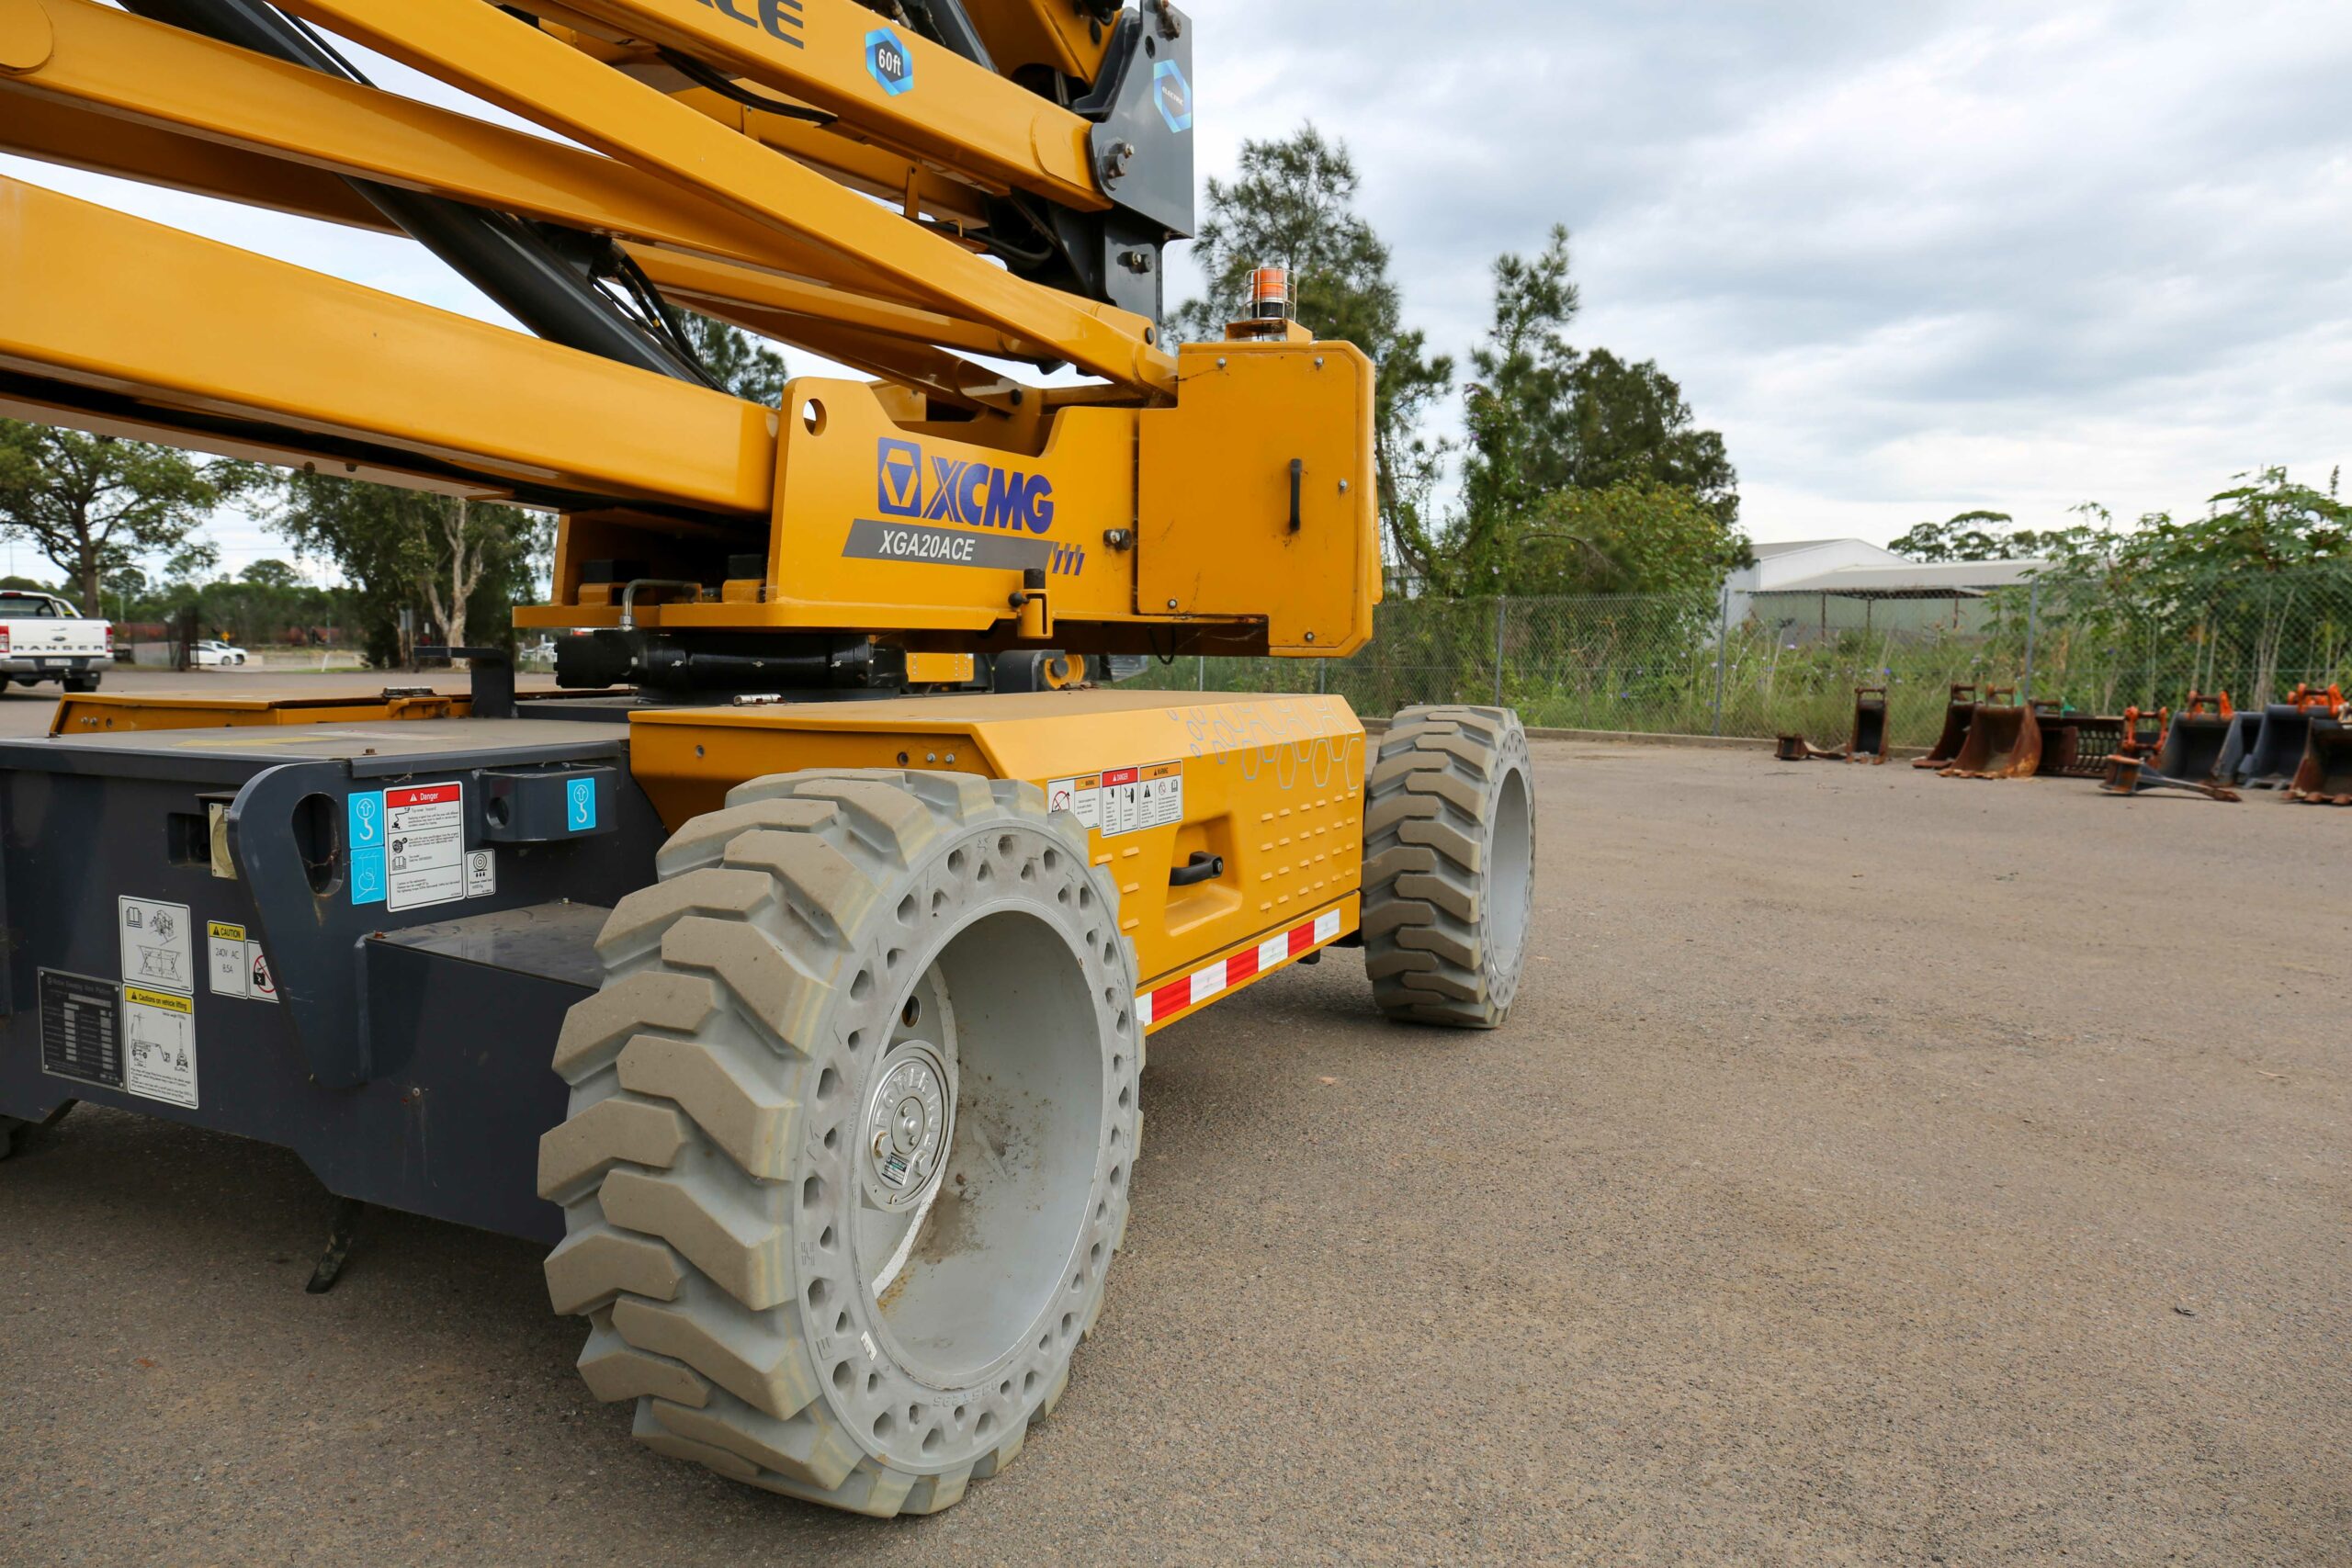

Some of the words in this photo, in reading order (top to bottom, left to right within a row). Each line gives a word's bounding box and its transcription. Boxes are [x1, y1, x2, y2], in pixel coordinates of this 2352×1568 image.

[877, 48, 902, 76] 60ft
[1161, 85, 1184, 107] ELECTRIC
[922, 455, 1054, 535] XCMG
[878, 529, 976, 561] XGA20ACE
[1116, 773, 1129, 781] DANGER
[420, 791, 438, 802] Danger
[220, 928, 241, 939] CAUTION
[215, 948, 229, 957] 240V
[231, 951, 240, 960] AC
